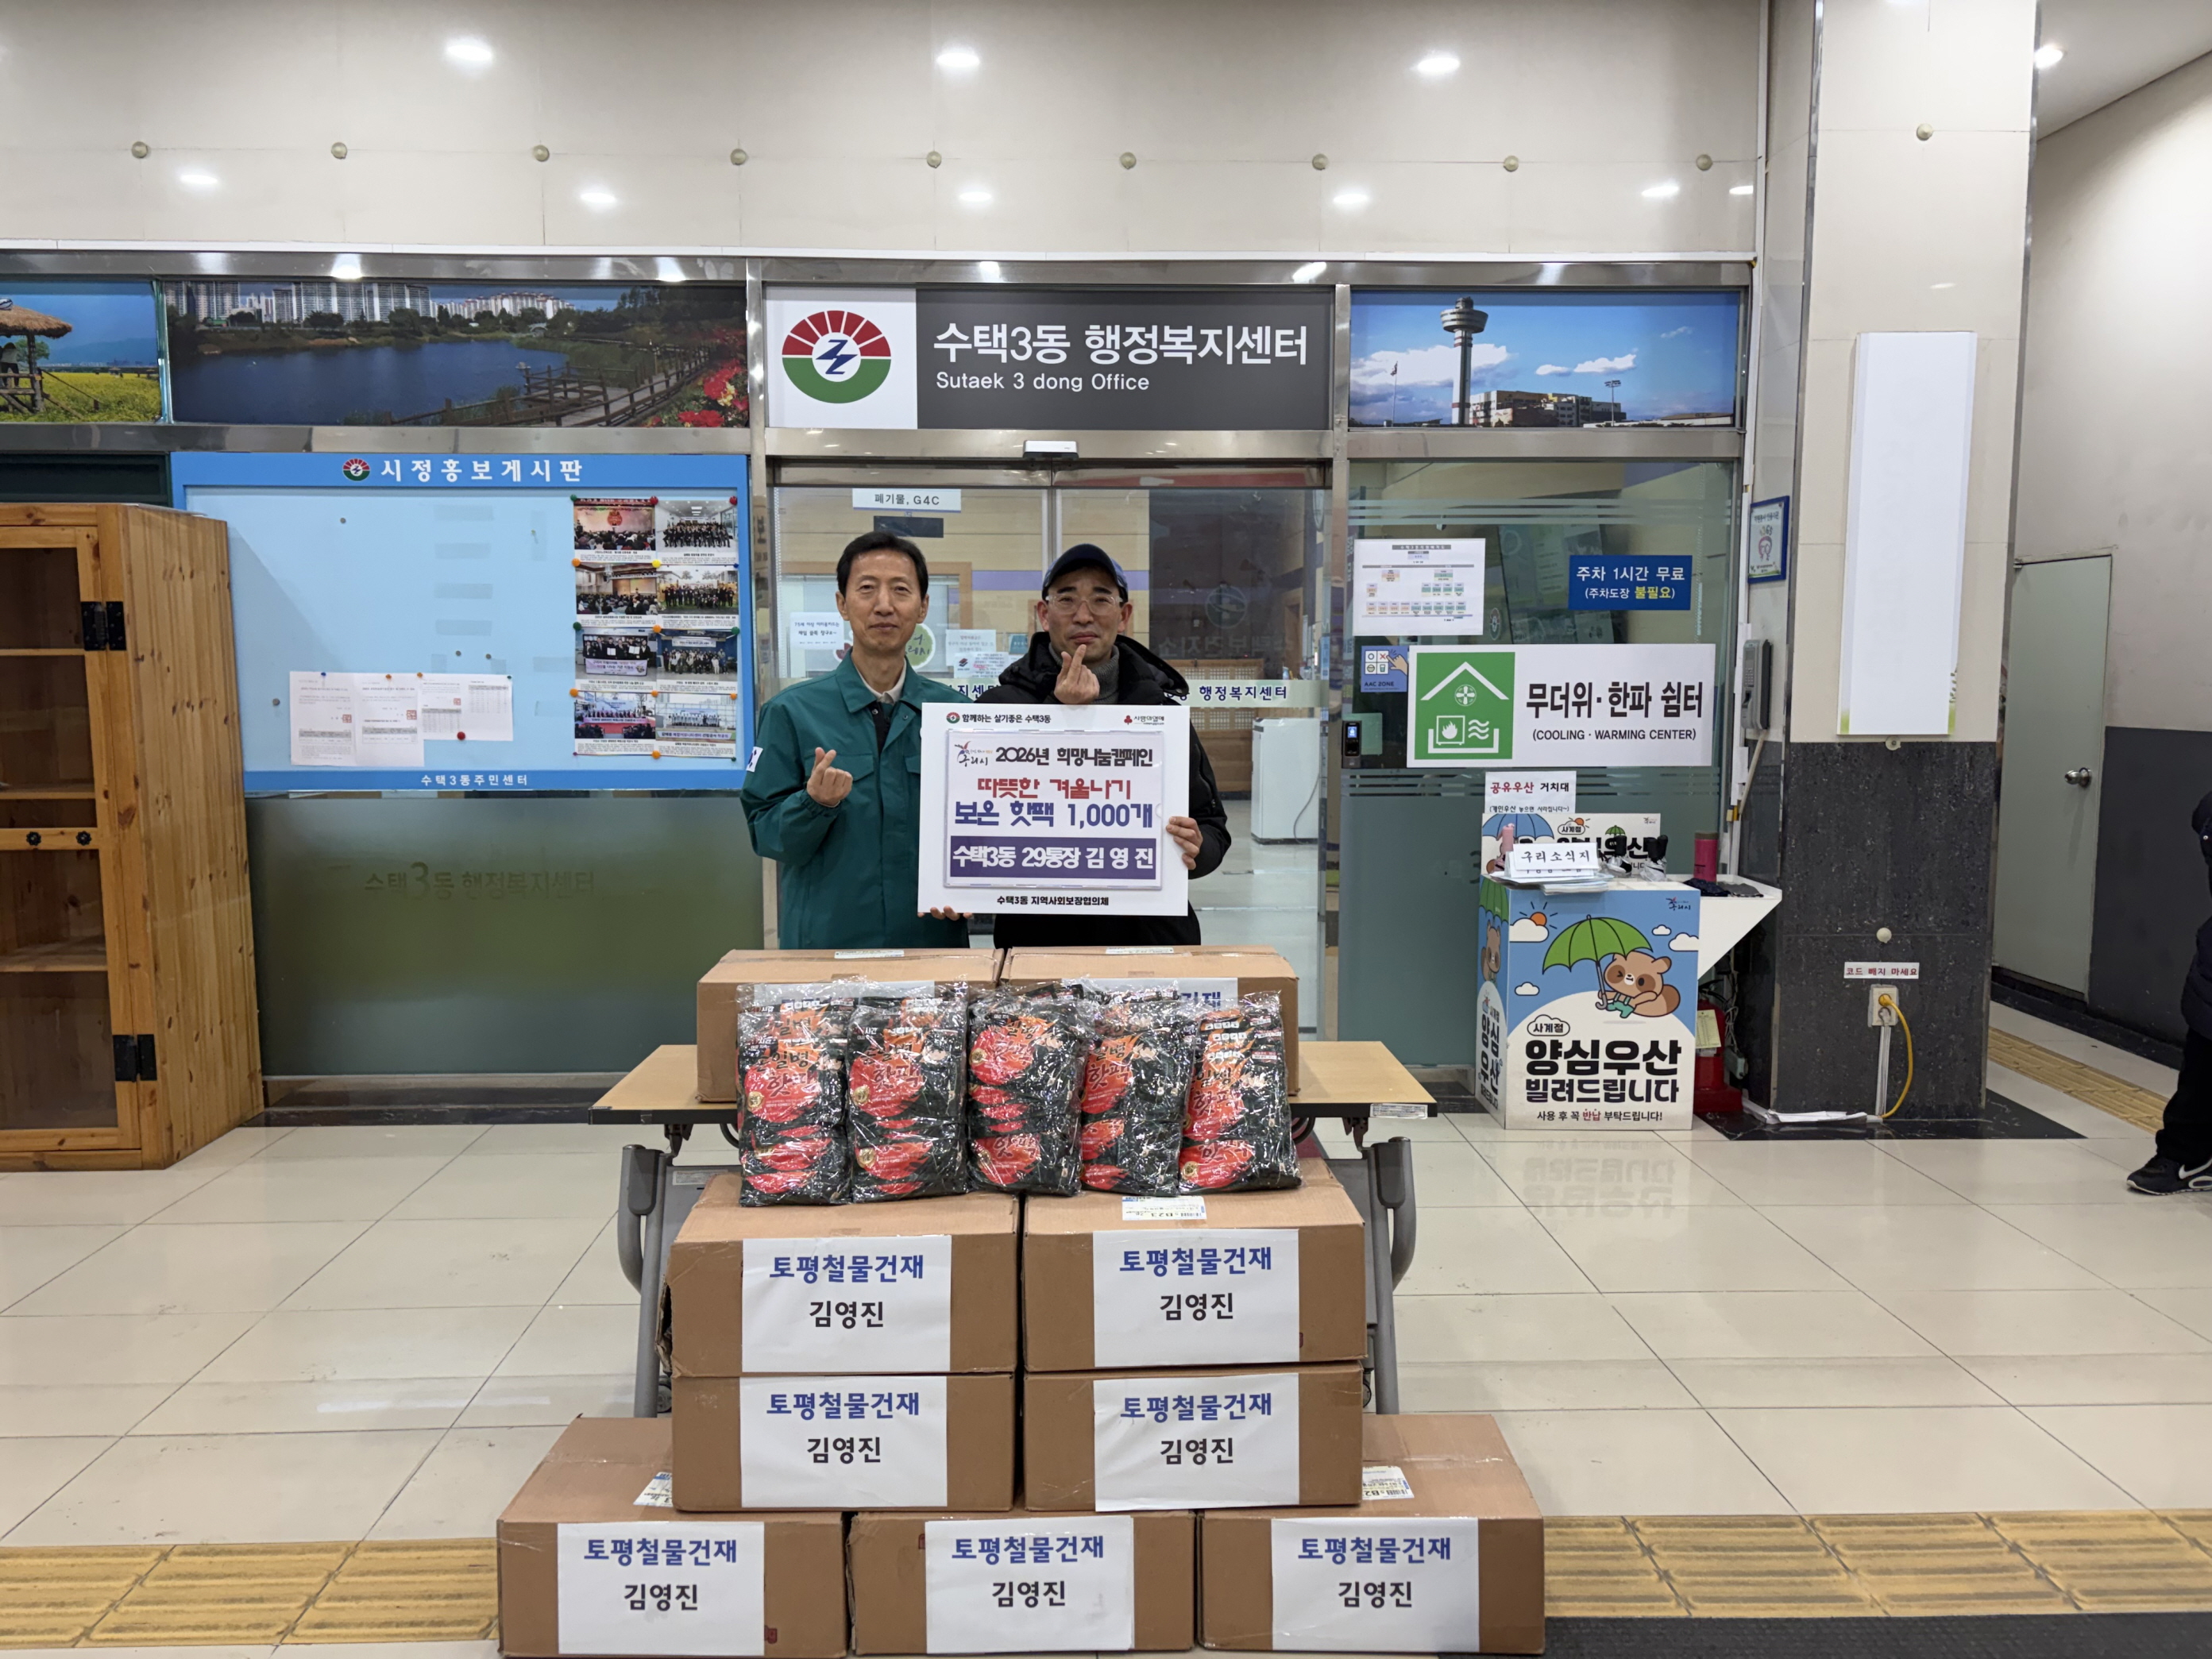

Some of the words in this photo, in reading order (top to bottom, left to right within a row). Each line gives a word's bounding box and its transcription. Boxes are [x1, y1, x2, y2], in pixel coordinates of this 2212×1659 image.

[933, 322, 1071, 366] 수택3동
[1085, 324, 1309, 367] 행정복지센터
[936, 371, 1005, 390] Sutaek
[1013, 372, 1025, 390] 3
[1033, 372, 1083, 392] dong
[1091, 372, 1150, 391] Office
[874, 494, 909, 505] 폐기물,
[913, 496, 940, 505] G4C
[1576, 565, 1606, 581] 주차
[1612, 565, 1649, 582] 1시간
[1655, 565, 1685, 581] 무료
[1585, 587, 1630, 599] (주차도장
[1634, 586, 1676, 600] 불필요)
[1199, 686, 1287, 700] 행정복지센터
[1661, 681, 1704, 719] 쉼터
[962, 714, 992, 723] 함께하는
[994, 714, 1023, 723] 살기좋은
[1025, 714, 1052, 723] 수택3동
[1533, 728, 1585, 742] (COOLING
[1595, 729, 1646, 741] WARMING
[1649, 728, 1697, 742] CENTER)
[995, 747, 1049, 766] 2026년
[1056, 747, 1153, 767] 희망나눔캠페인
[977, 777, 1040, 799] 따뜻한
[1049, 777, 1131, 800] 겨울나기
[1490, 782, 1534, 793] 공유우산
[1540, 782, 1569, 792] 거치대
[955, 801, 1000, 826] 보온
[1009, 801, 1054, 828] 핫팩
[1067, 804, 1153, 829] 1,000개
[953, 845, 1017, 867] 수택3동
[1021, 847, 1081, 869] 29통장
[1521, 851, 1589, 863] 구리소식지
[997, 896, 1029, 905] 수택3동
[1032, 896, 1110, 906] 지역사회보장협의체
[1533, 1023, 1564, 1033] 사계절
[1525, 1040, 1682, 1076] 양심우산
[1088, 1063, 1131, 1090] 핫팩
[1525, 1078, 1680, 1103] 빌려드립니다
[1537, 1111, 1556, 1121] 사용
[1558, 1111, 1568, 1121] 후
[1571, 1111, 1580, 1121] 꼭
[1583, 1110, 1600, 1121] 반납
[1604, 1111, 1662, 1121] 부탁드립니다!
[770, 1255, 923, 1283] 토평철물건재
[1120, 1247, 1272, 1276] 토평철물건재
[810, 1301, 883, 1329] 김영진
[1160, 1293, 1233, 1321] 김영진
[767, 1392, 919, 1421] 토평철물건재
[1121, 1393, 1272, 1422] 토평철물건재
[808, 1437, 880, 1464] 김영진
[1160, 1438, 1233, 1465] 김영진
[585, 1538, 737, 1566] 토평철물건재
[952, 1536, 1105, 1564] 토평철물건재
[1299, 1537, 1451, 1564] 토평철물건재
[625, 1584, 697, 1611] 김영진
[993, 1581, 1065, 1608] 김영진
[1339, 1582, 1411, 1609] 김영진
